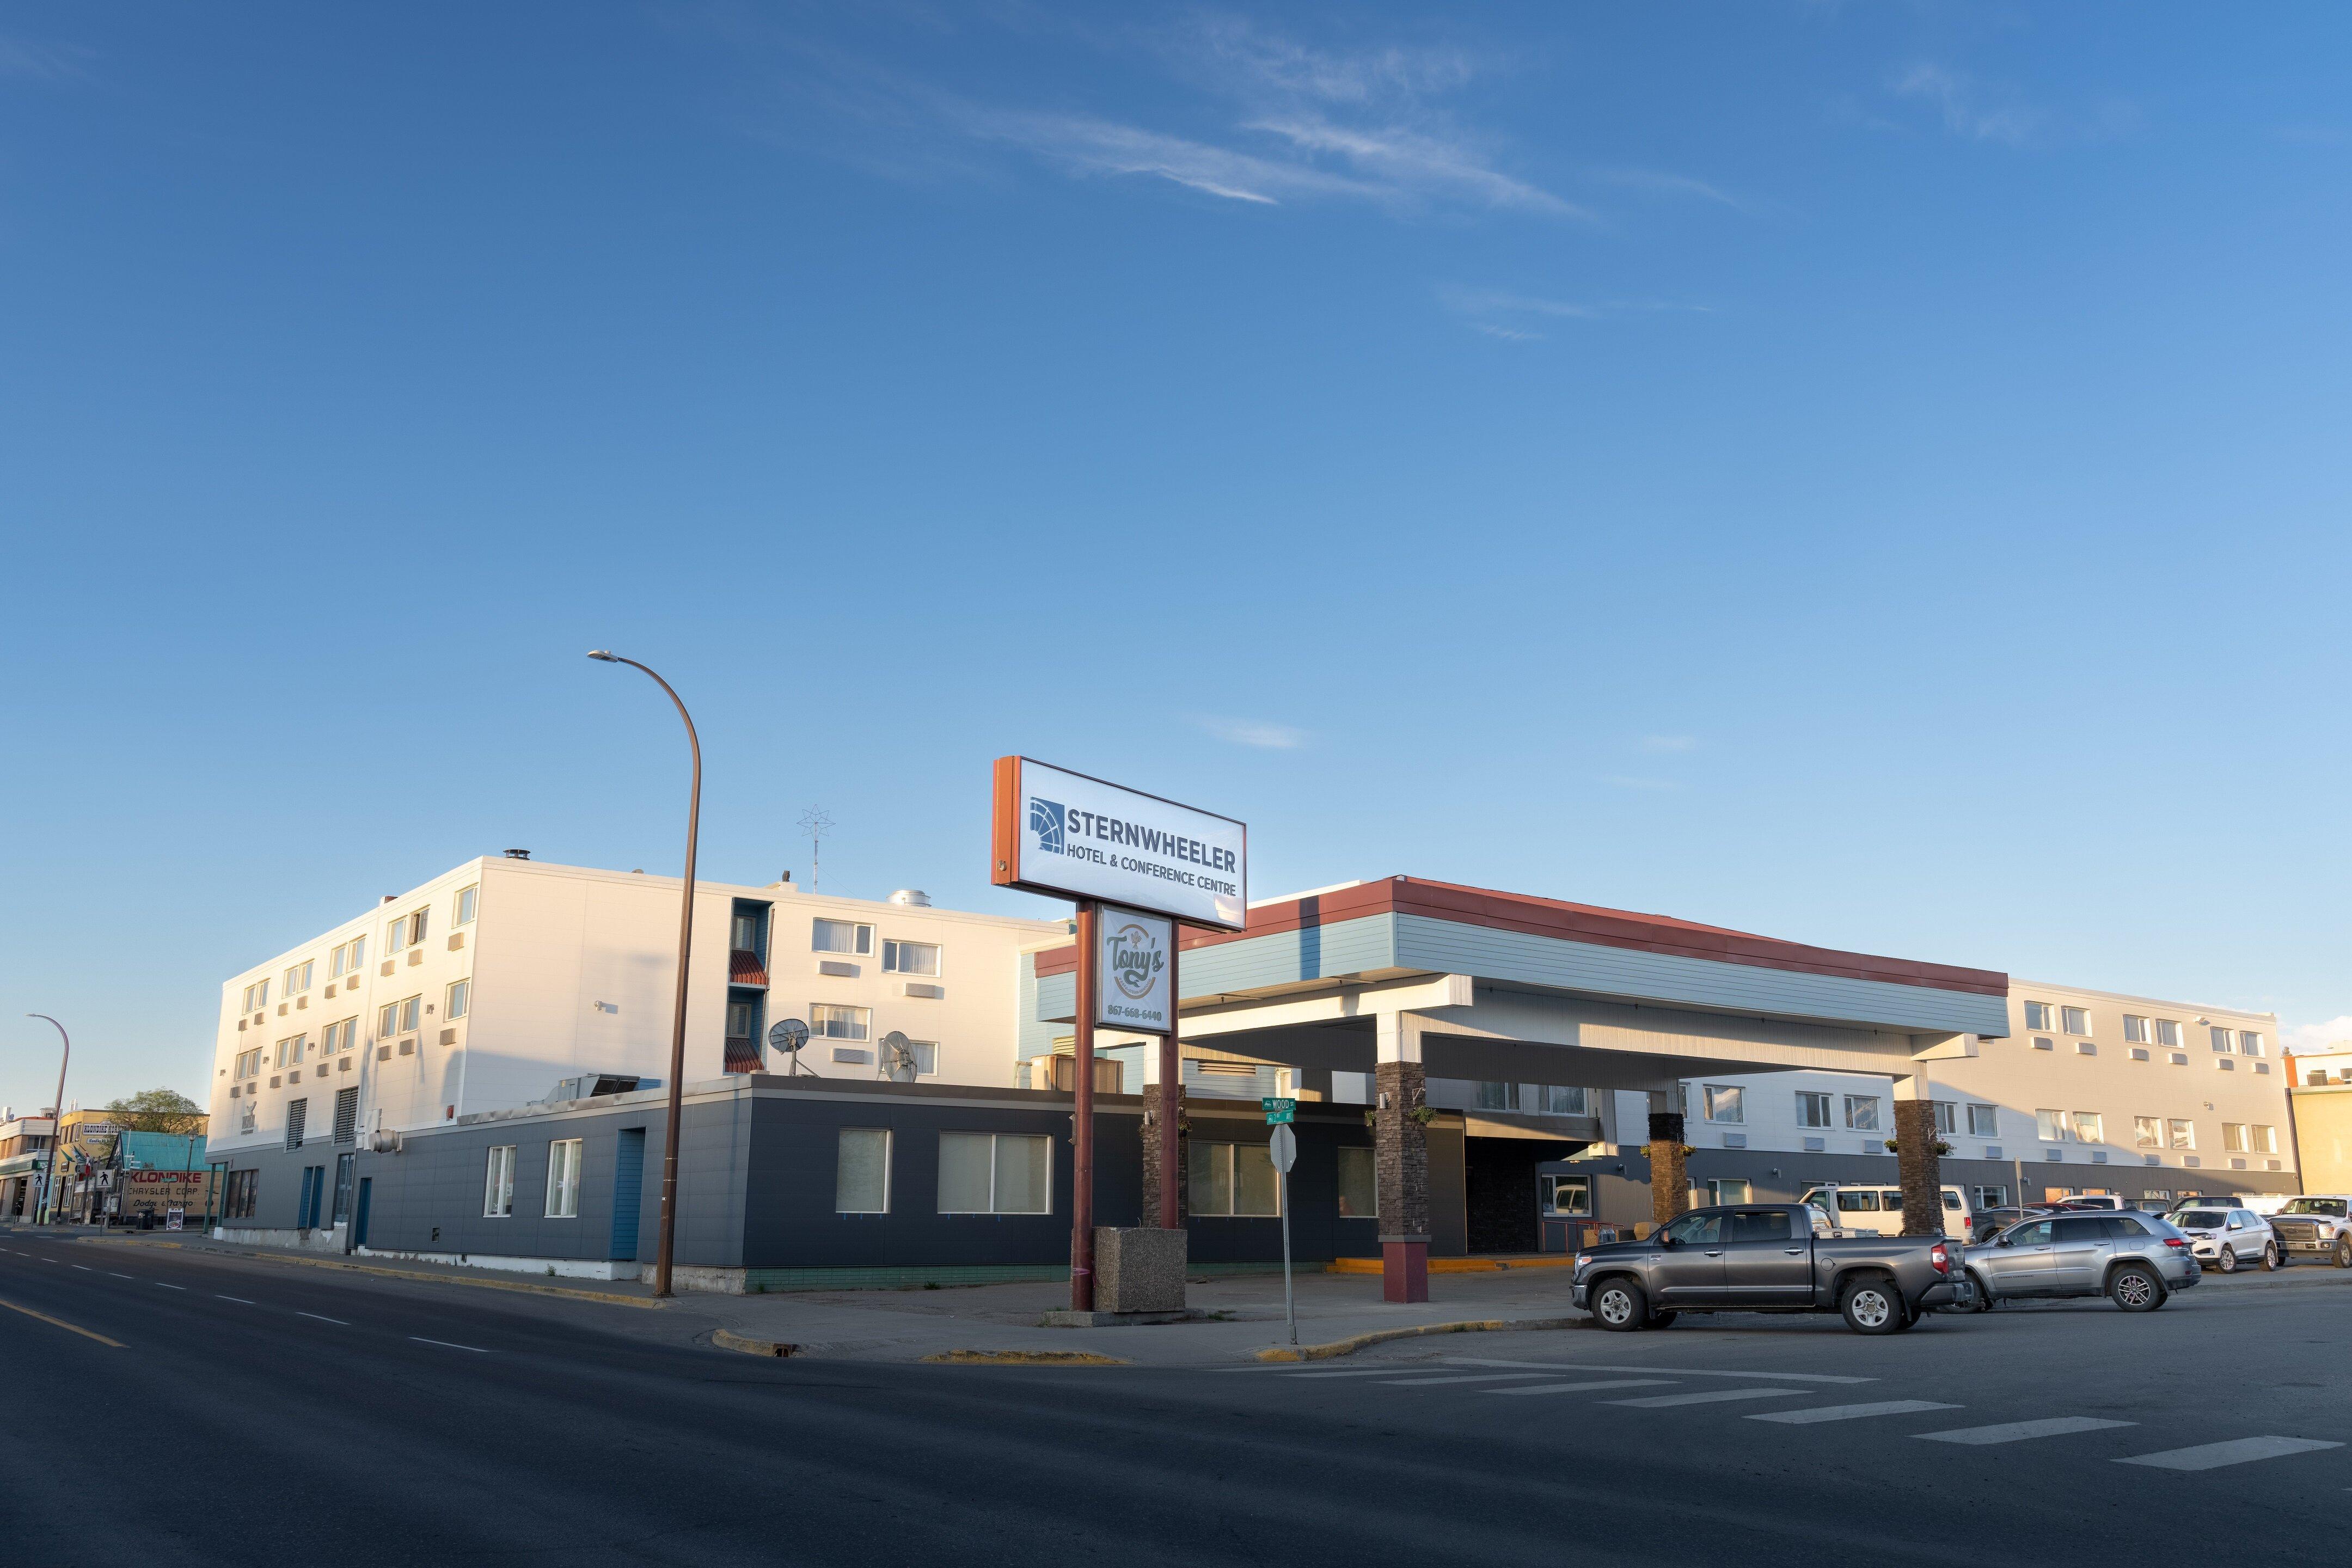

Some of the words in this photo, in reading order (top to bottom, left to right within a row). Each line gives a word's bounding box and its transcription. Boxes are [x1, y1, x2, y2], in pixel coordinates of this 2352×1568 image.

[1068, 809, 1235, 873] STERNWHEELER
[1067, 843, 1106, 865] HOTEL
[1110, 854, 1118, 867] &
[1121, 857, 1195, 886] CONFERENCE
[1197, 876, 1236, 896] CENTRE
[1107, 935, 1164, 988] Tony's
[1107, 1004, 1162, 1021] 867-668-6440
[1272, 1099, 1289, 1108] WOOD
[130, 1172, 201, 1183] KLONDIKE
[133, 1199, 157, 1208] Dodge
